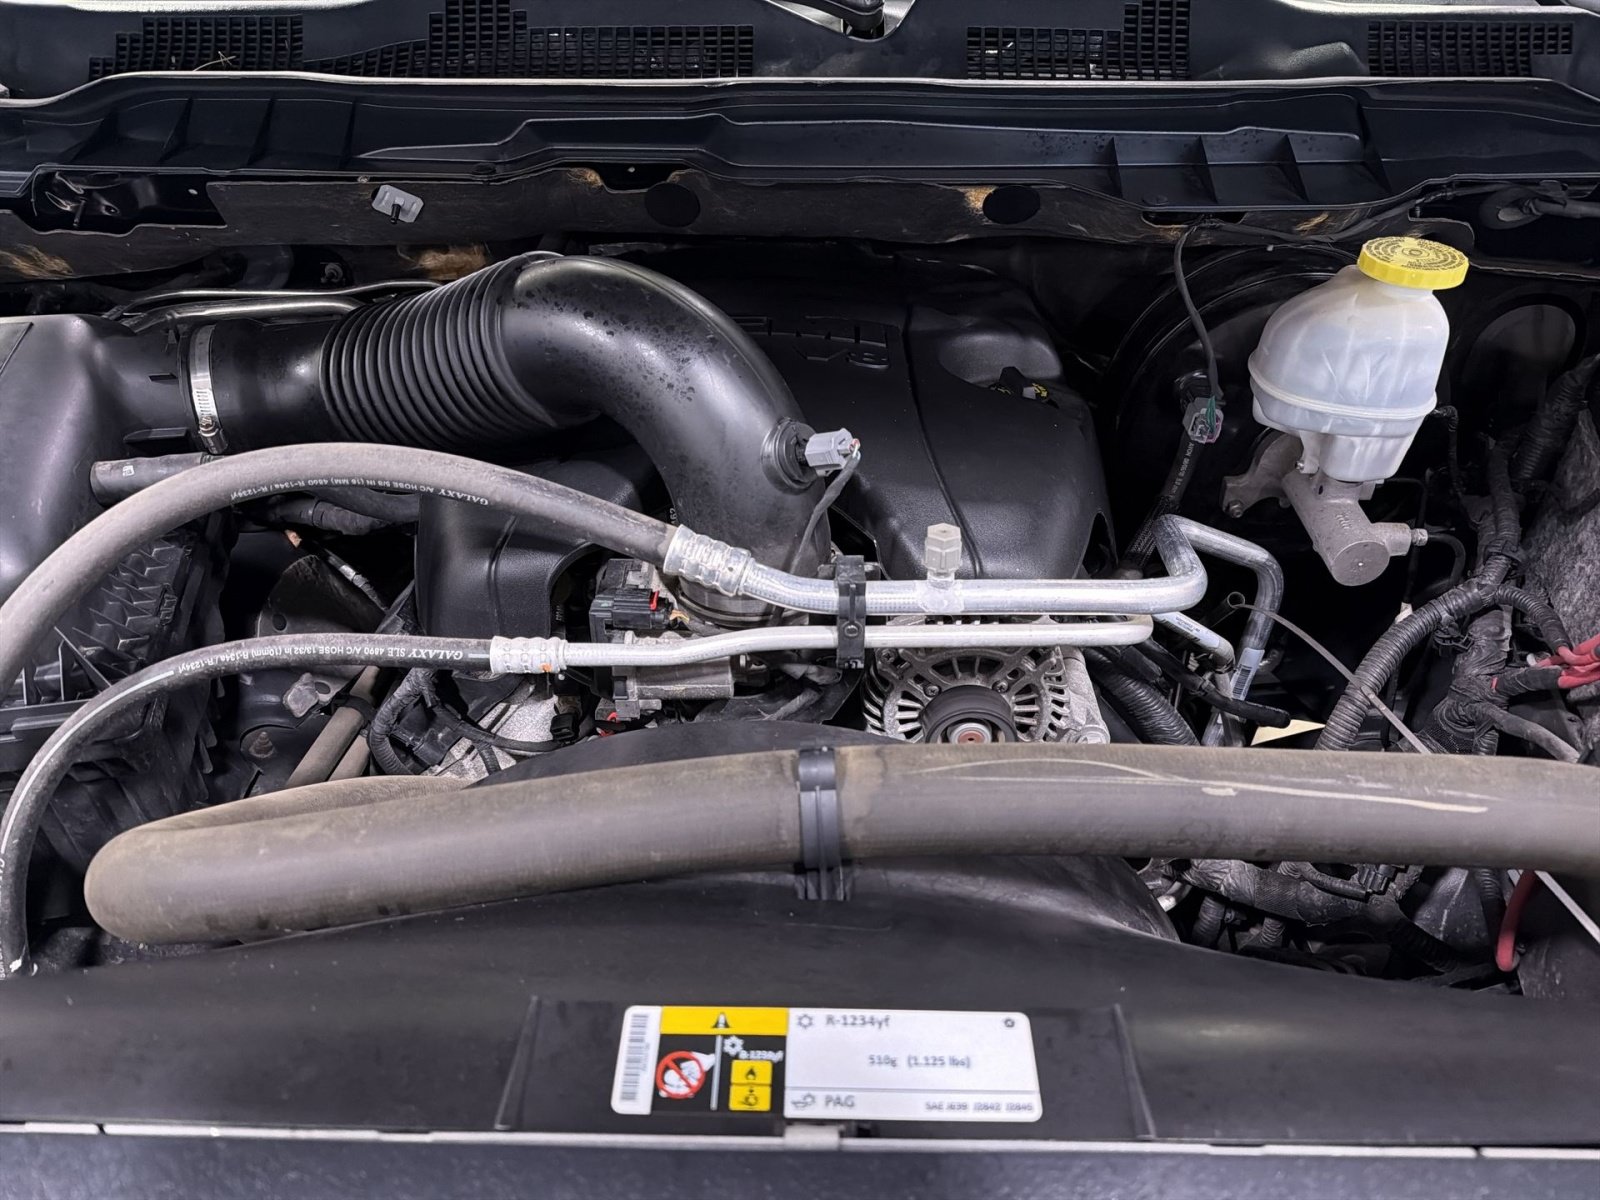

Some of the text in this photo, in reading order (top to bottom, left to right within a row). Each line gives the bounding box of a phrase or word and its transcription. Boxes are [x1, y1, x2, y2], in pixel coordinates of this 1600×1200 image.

[393, 481, 417, 491] HOSE
[420, 485, 434, 493] A/C
[439, 488, 489, 506] GALAXY
[293, 644, 317, 655] 13/32
[319, 645, 344, 655] HOSE
[346, 645, 361, 655] A/C
[363, 646, 385, 656] 4890
[387, 646, 406, 657] SLE
[408, 648, 464, 661] GALAXY
[825, 1014, 891, 1029] R-1234yf
[949, 1056, 971, 1068] lbs)
[824, 1096, 855, 1108] PAG
